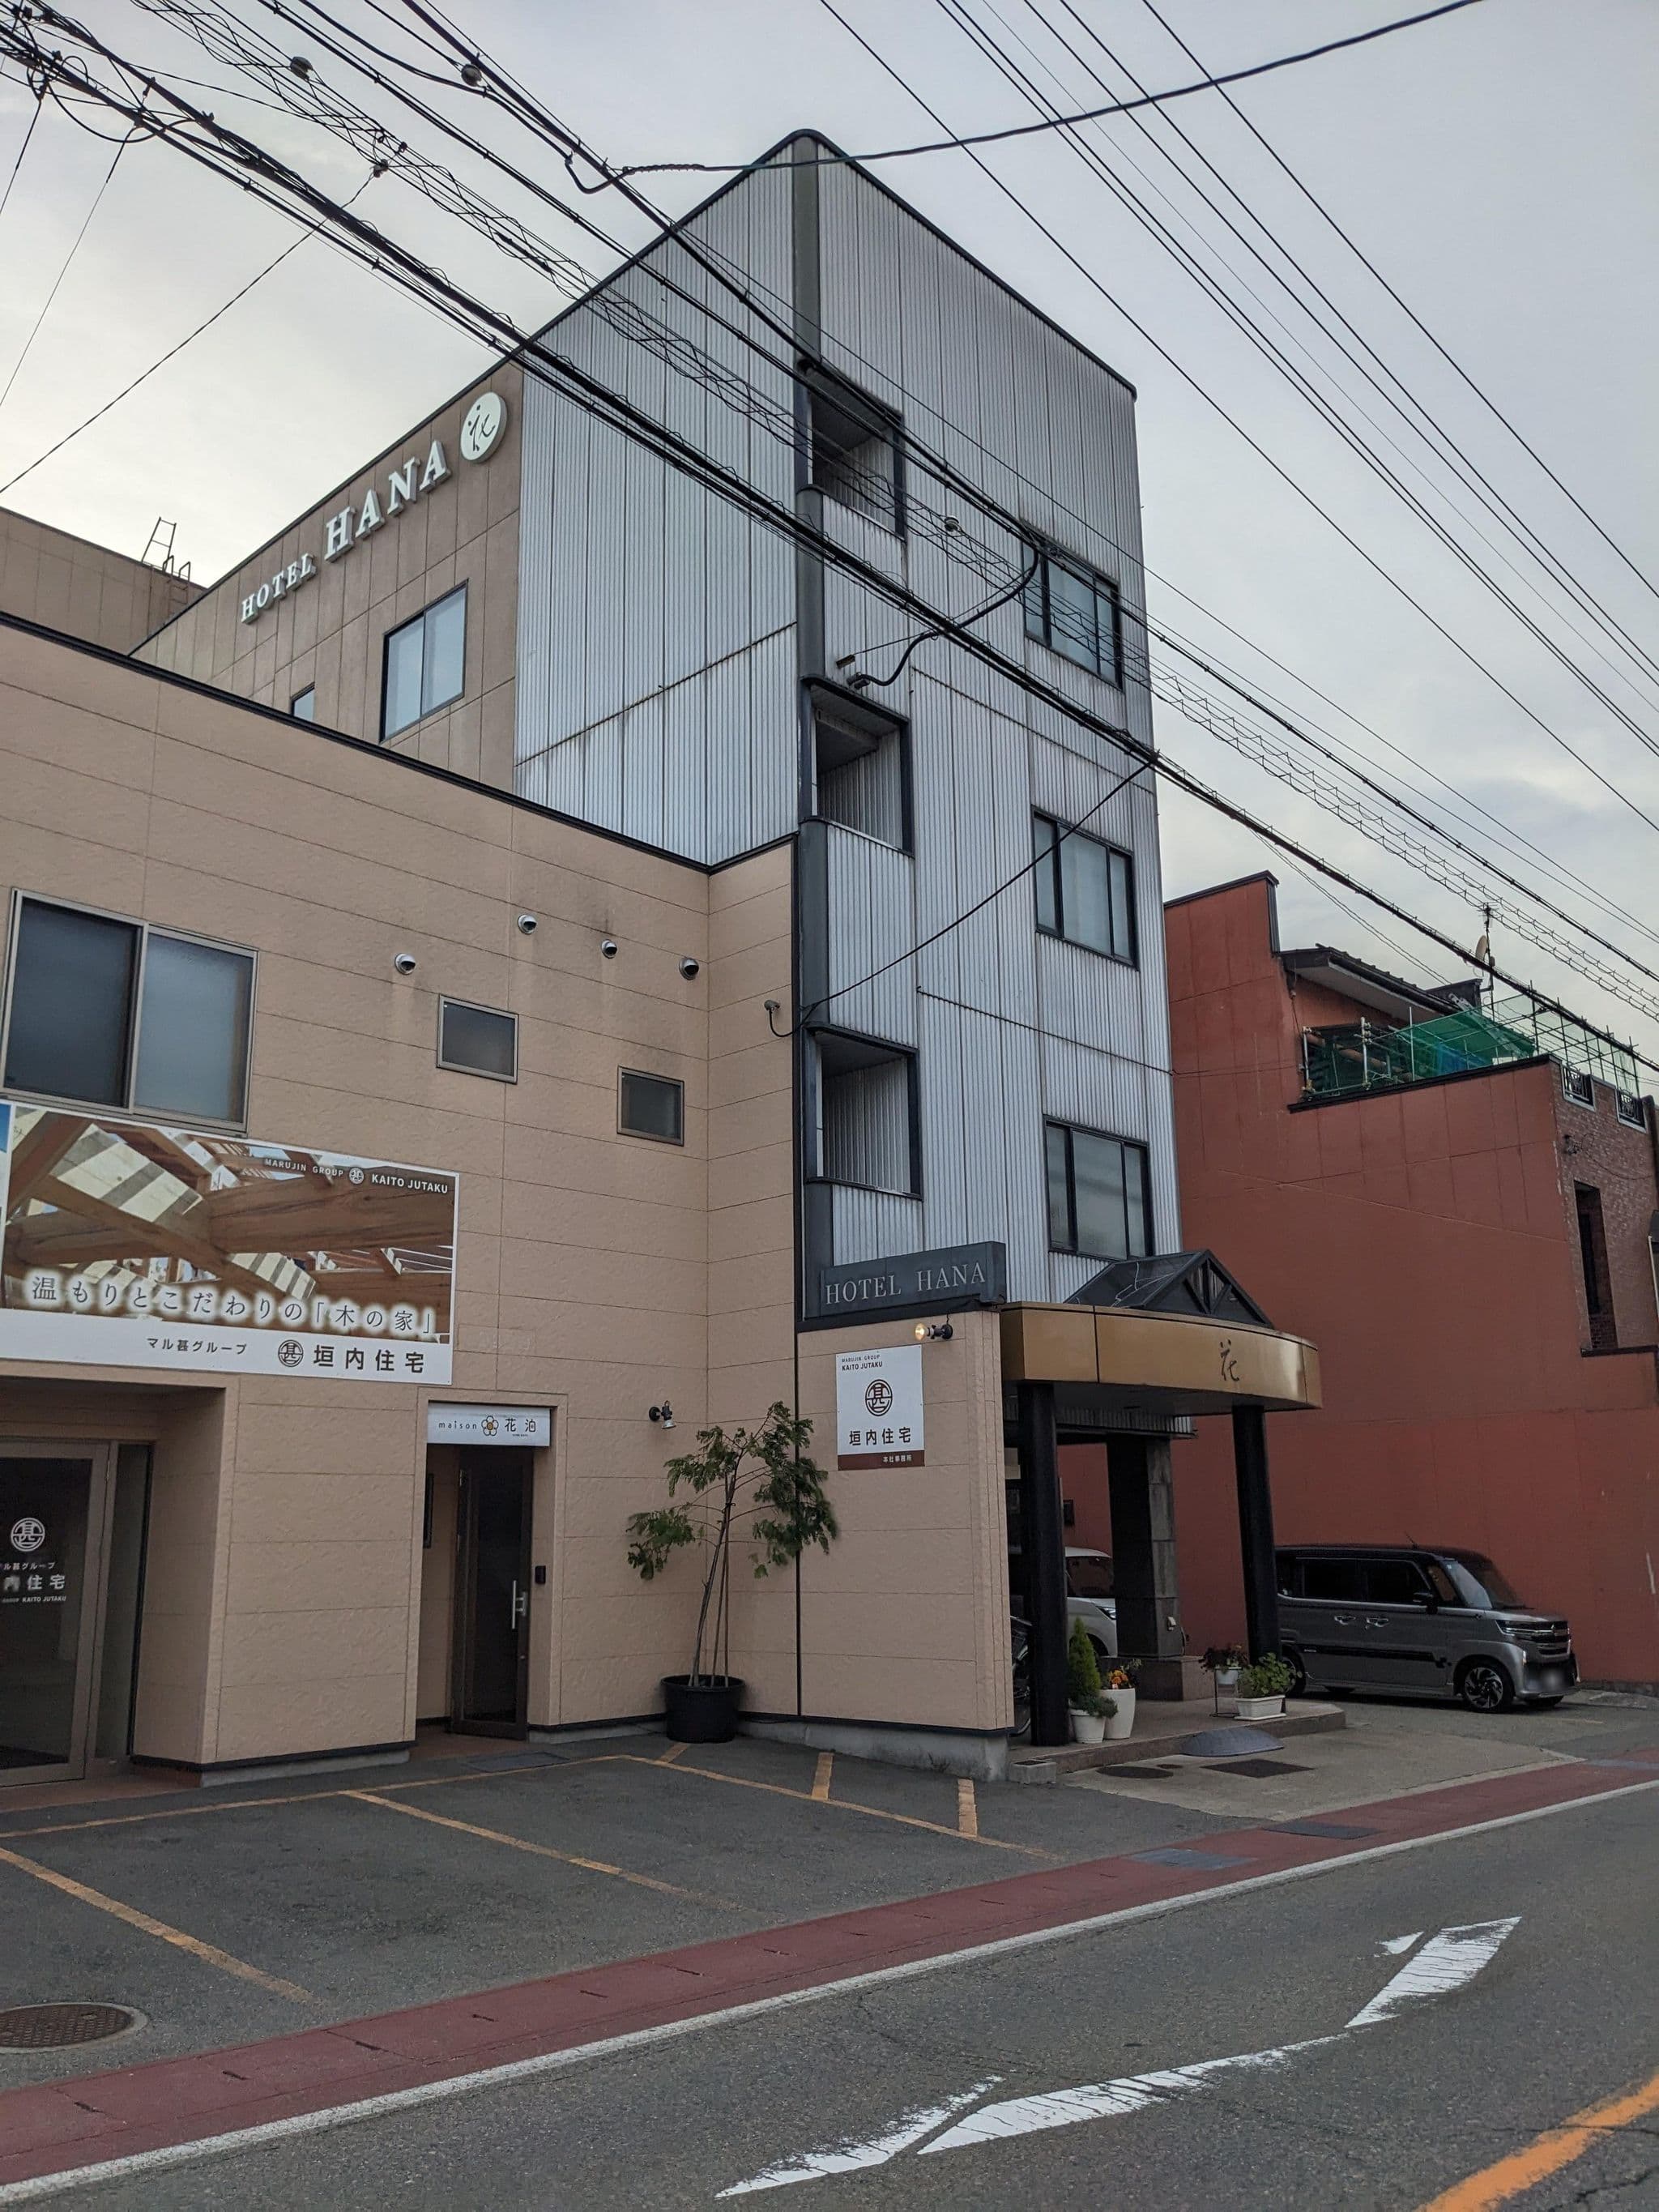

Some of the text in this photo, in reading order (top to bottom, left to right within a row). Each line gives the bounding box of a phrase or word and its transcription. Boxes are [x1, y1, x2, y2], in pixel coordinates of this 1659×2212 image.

[241, 439, 452, 625] HOTEL HANA
[264, 1158, 307, 1172] MARUJIN
[312, 1165, 344, 1177] GROUP
[371, 1172, 406, 1188] KAITO
[407, 1180, 449, 1194] JUTAKU
[825, 1262, 986, 1305] HOTEL HANA
[32, 1275, 431, 1334] 温もりとこだわりの「木の家」
[146, 1337, 248, 1356] マル甚グループ
[313, 1343, 424, 1374] 垣内住宅
[842, 1360, 884, 1372] KAITO JUTAKU
[438, 1420, 478, 1430] maison
[848, 1426, 912, 1446] 垣内住宅
